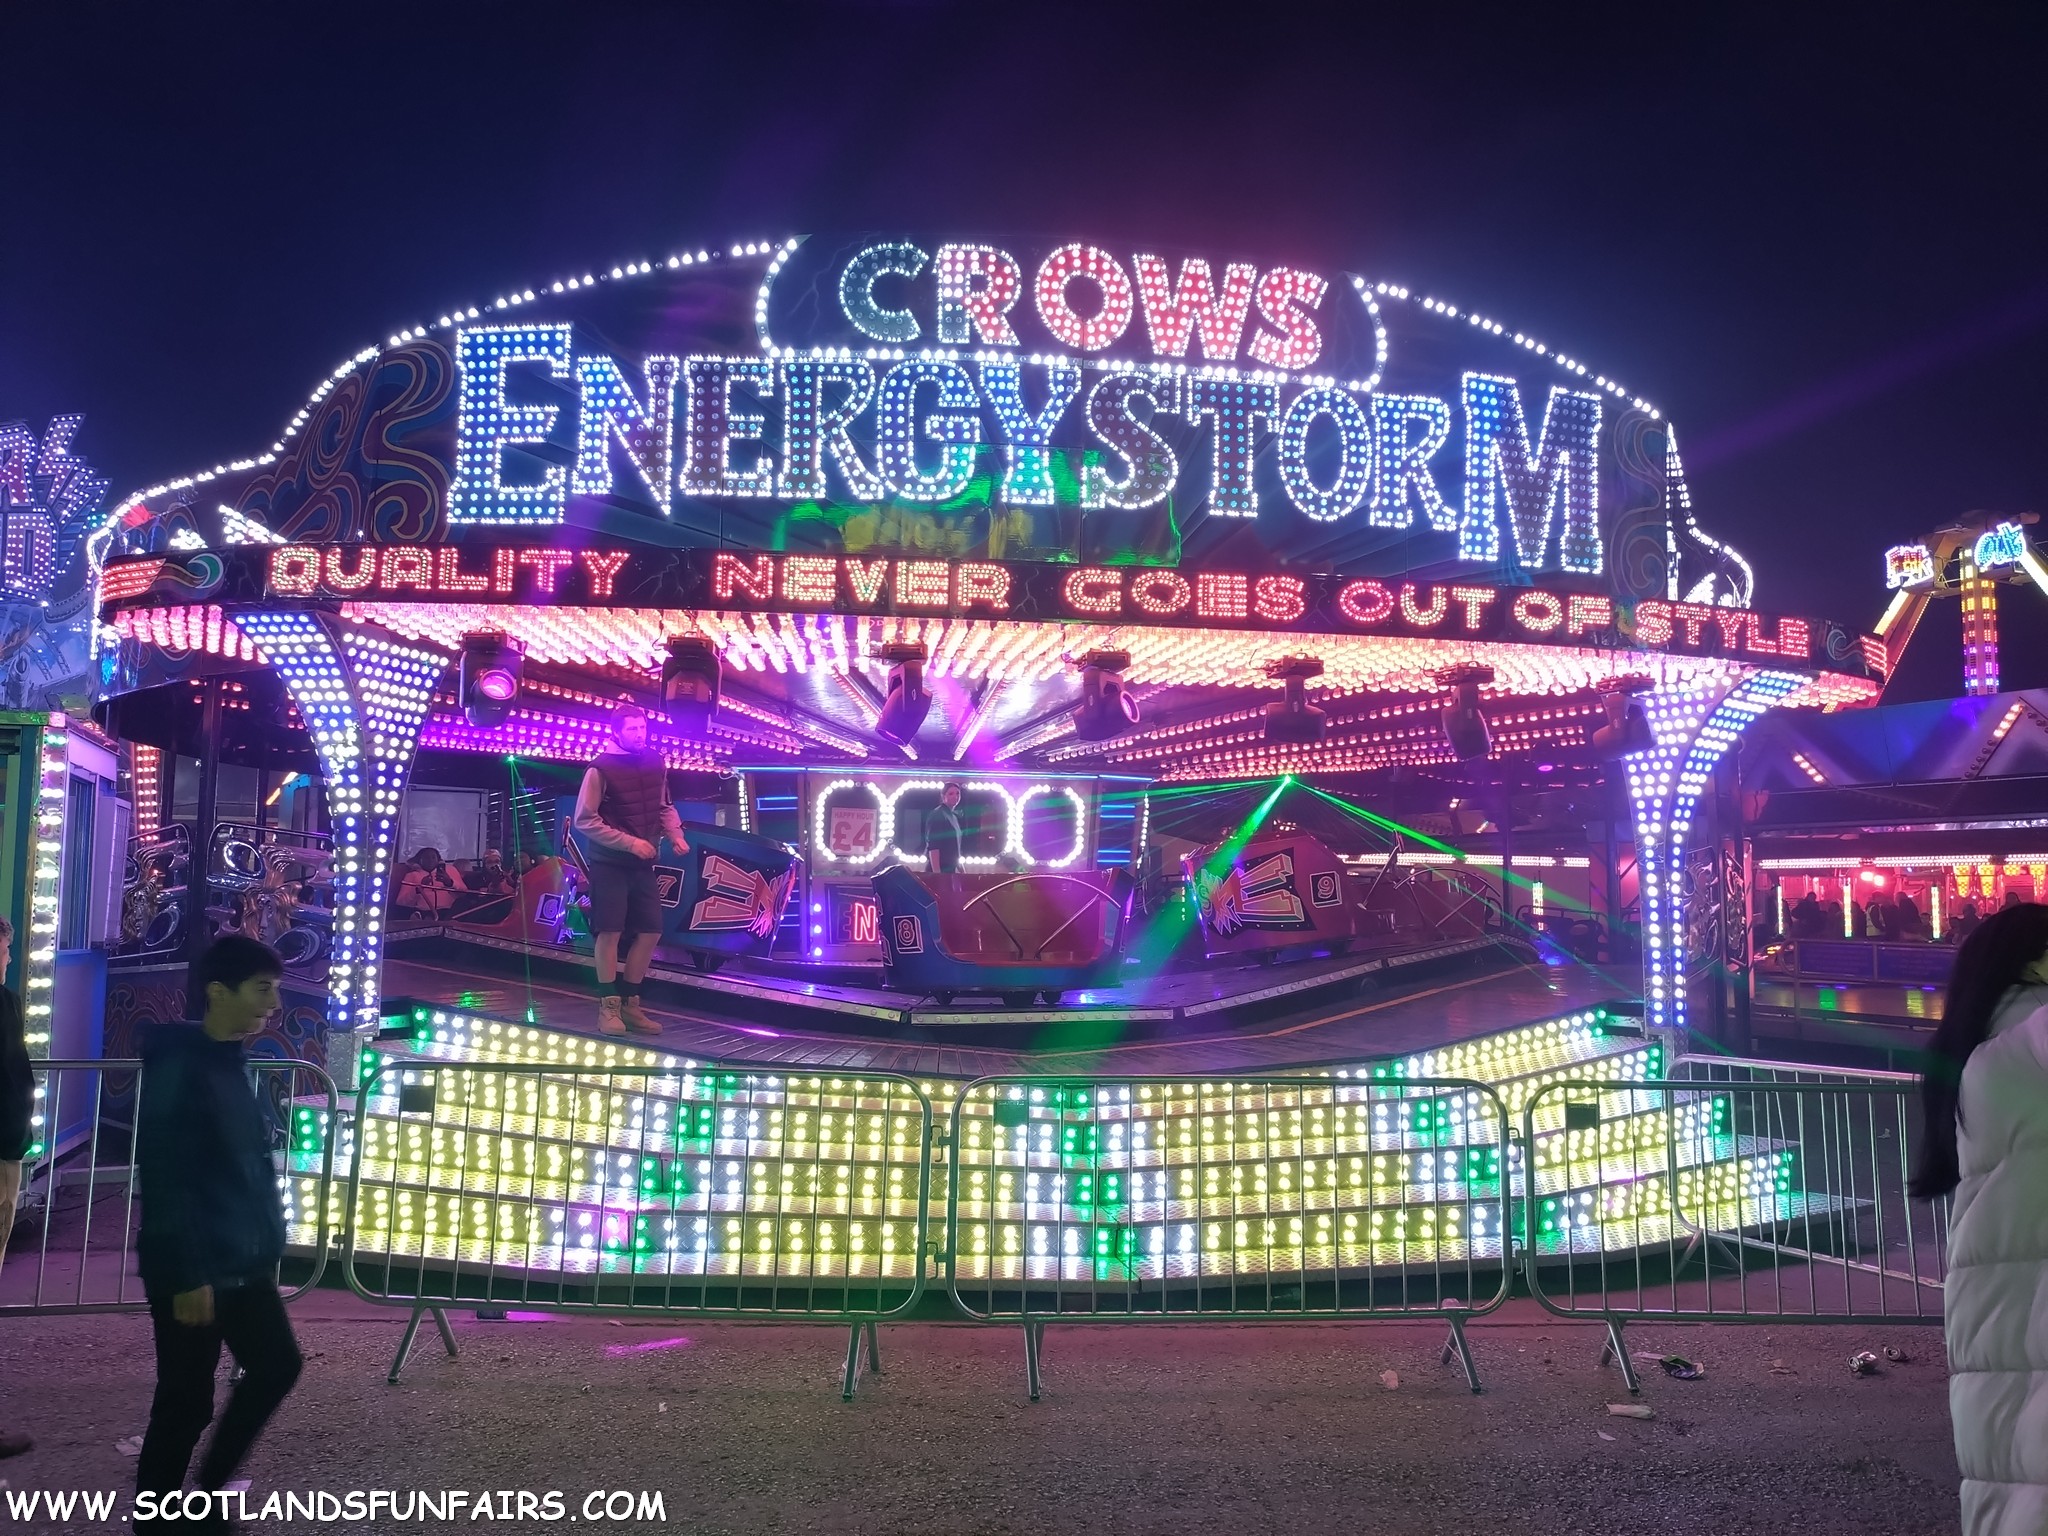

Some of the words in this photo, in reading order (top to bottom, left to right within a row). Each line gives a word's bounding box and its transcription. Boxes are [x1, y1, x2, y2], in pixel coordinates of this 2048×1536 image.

[839, 242, 1328, 370] CROWS
[446, 322, 1605, 573] ENERGYSTORM
[270, 547, 632, 596] QUALITY
[714, 552, 1011, 609] NEVER
[1062, 567, 1305, 622] GOES
[1338, 579, 1496, 632] OUT
[1513, 591, 1612, 636] OF
[1634, 601, 1809, 659] STYLE
[834, 811, 855, 820] HAPPY
[832, 821, 873, 852] £4
[658, 874, 678, 898] 7
[1318, 876, 1335, 899] 9
[897, 918, 915, 946] 8
